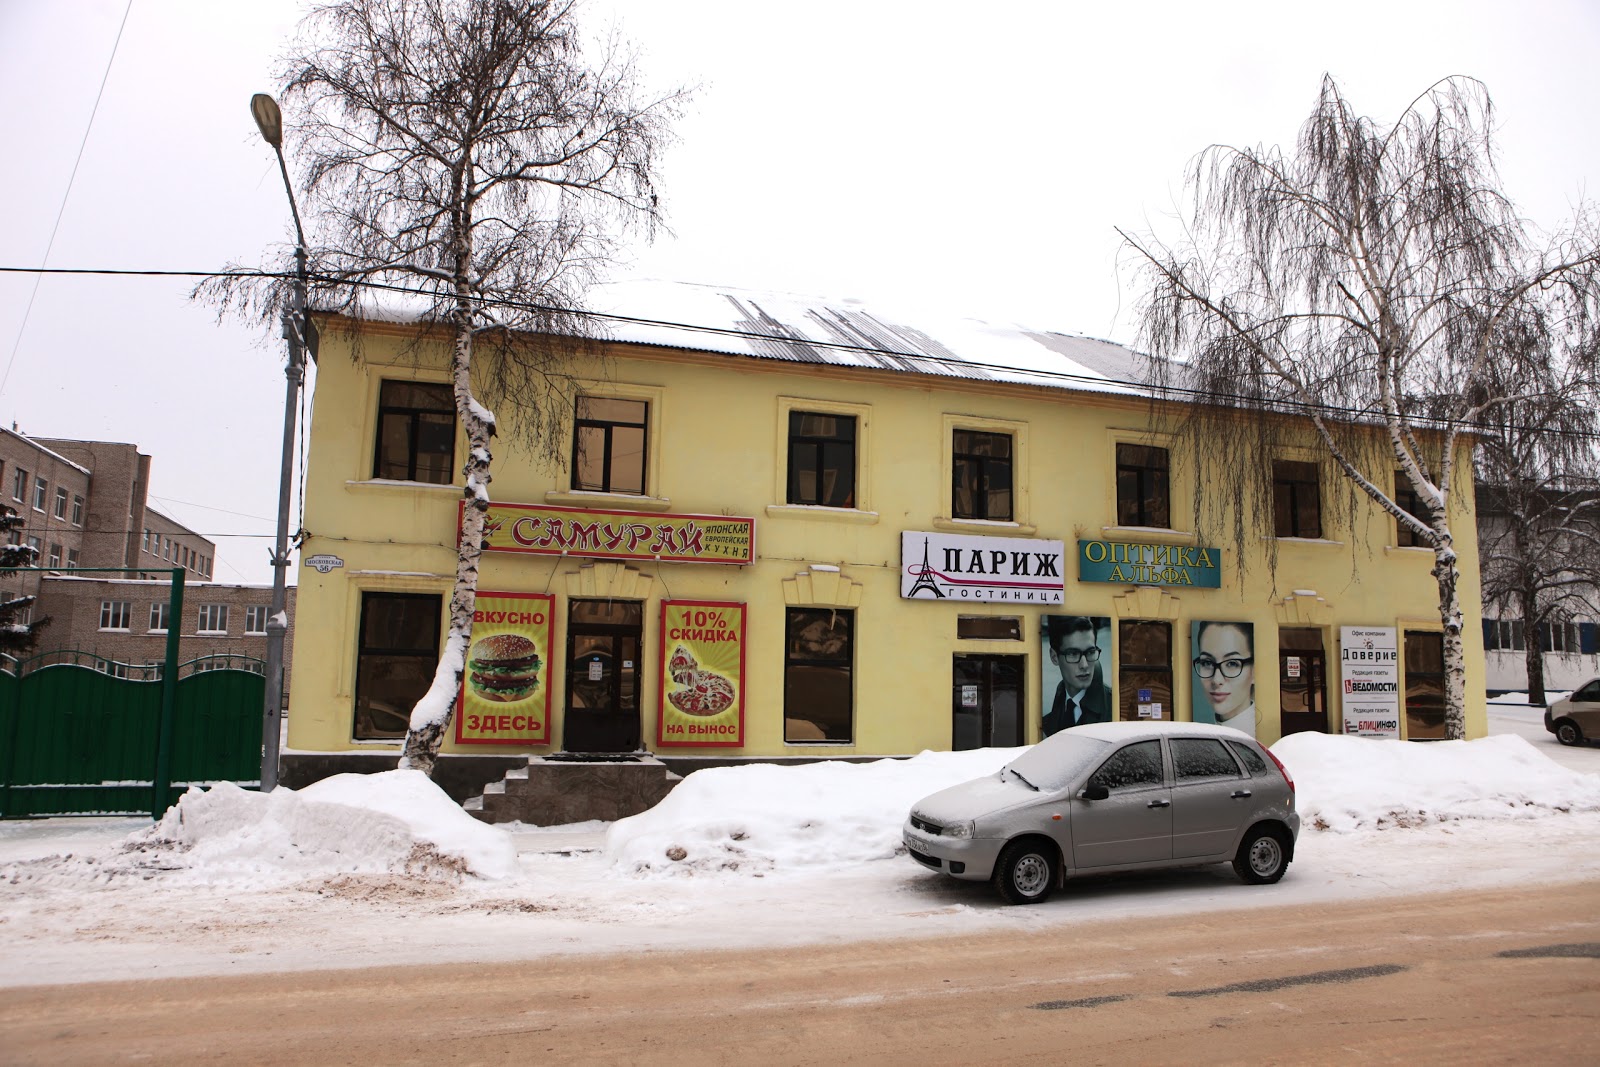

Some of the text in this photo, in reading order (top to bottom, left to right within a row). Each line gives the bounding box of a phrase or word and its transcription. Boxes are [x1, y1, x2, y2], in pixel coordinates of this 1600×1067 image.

[512, 516, 705, 555] САМУРАЙ
[705, 523, 749, 534] ЯПОНСКАЯ
[705, 535, 749, 545] ЕВРОПЕЙСКАЯ
[705, 544, 749, 558] КУХНЯ
[1085, 541, 1215, 568] ОПТИКА
[942, 547, 1060, 577] ПАРИЖ
[1108, 564, 1193, 585] АЛЬФА
[948, 588, 1060, 602] ГОСТИНИЦА
[473, 611, 545, 625] ВКУСНО
[681, 610, 727, 629] 10%
[669, 628, 738, 644] СКИДКА
[1342, 648, 1397, 662] Доверие
[1352, 683, 1397, 692] ВЕДОМОСТИ
[467, 714, 541, 733] ЗДЕСЬ
[666, 724, 736, 735] НА ВЫНОС
